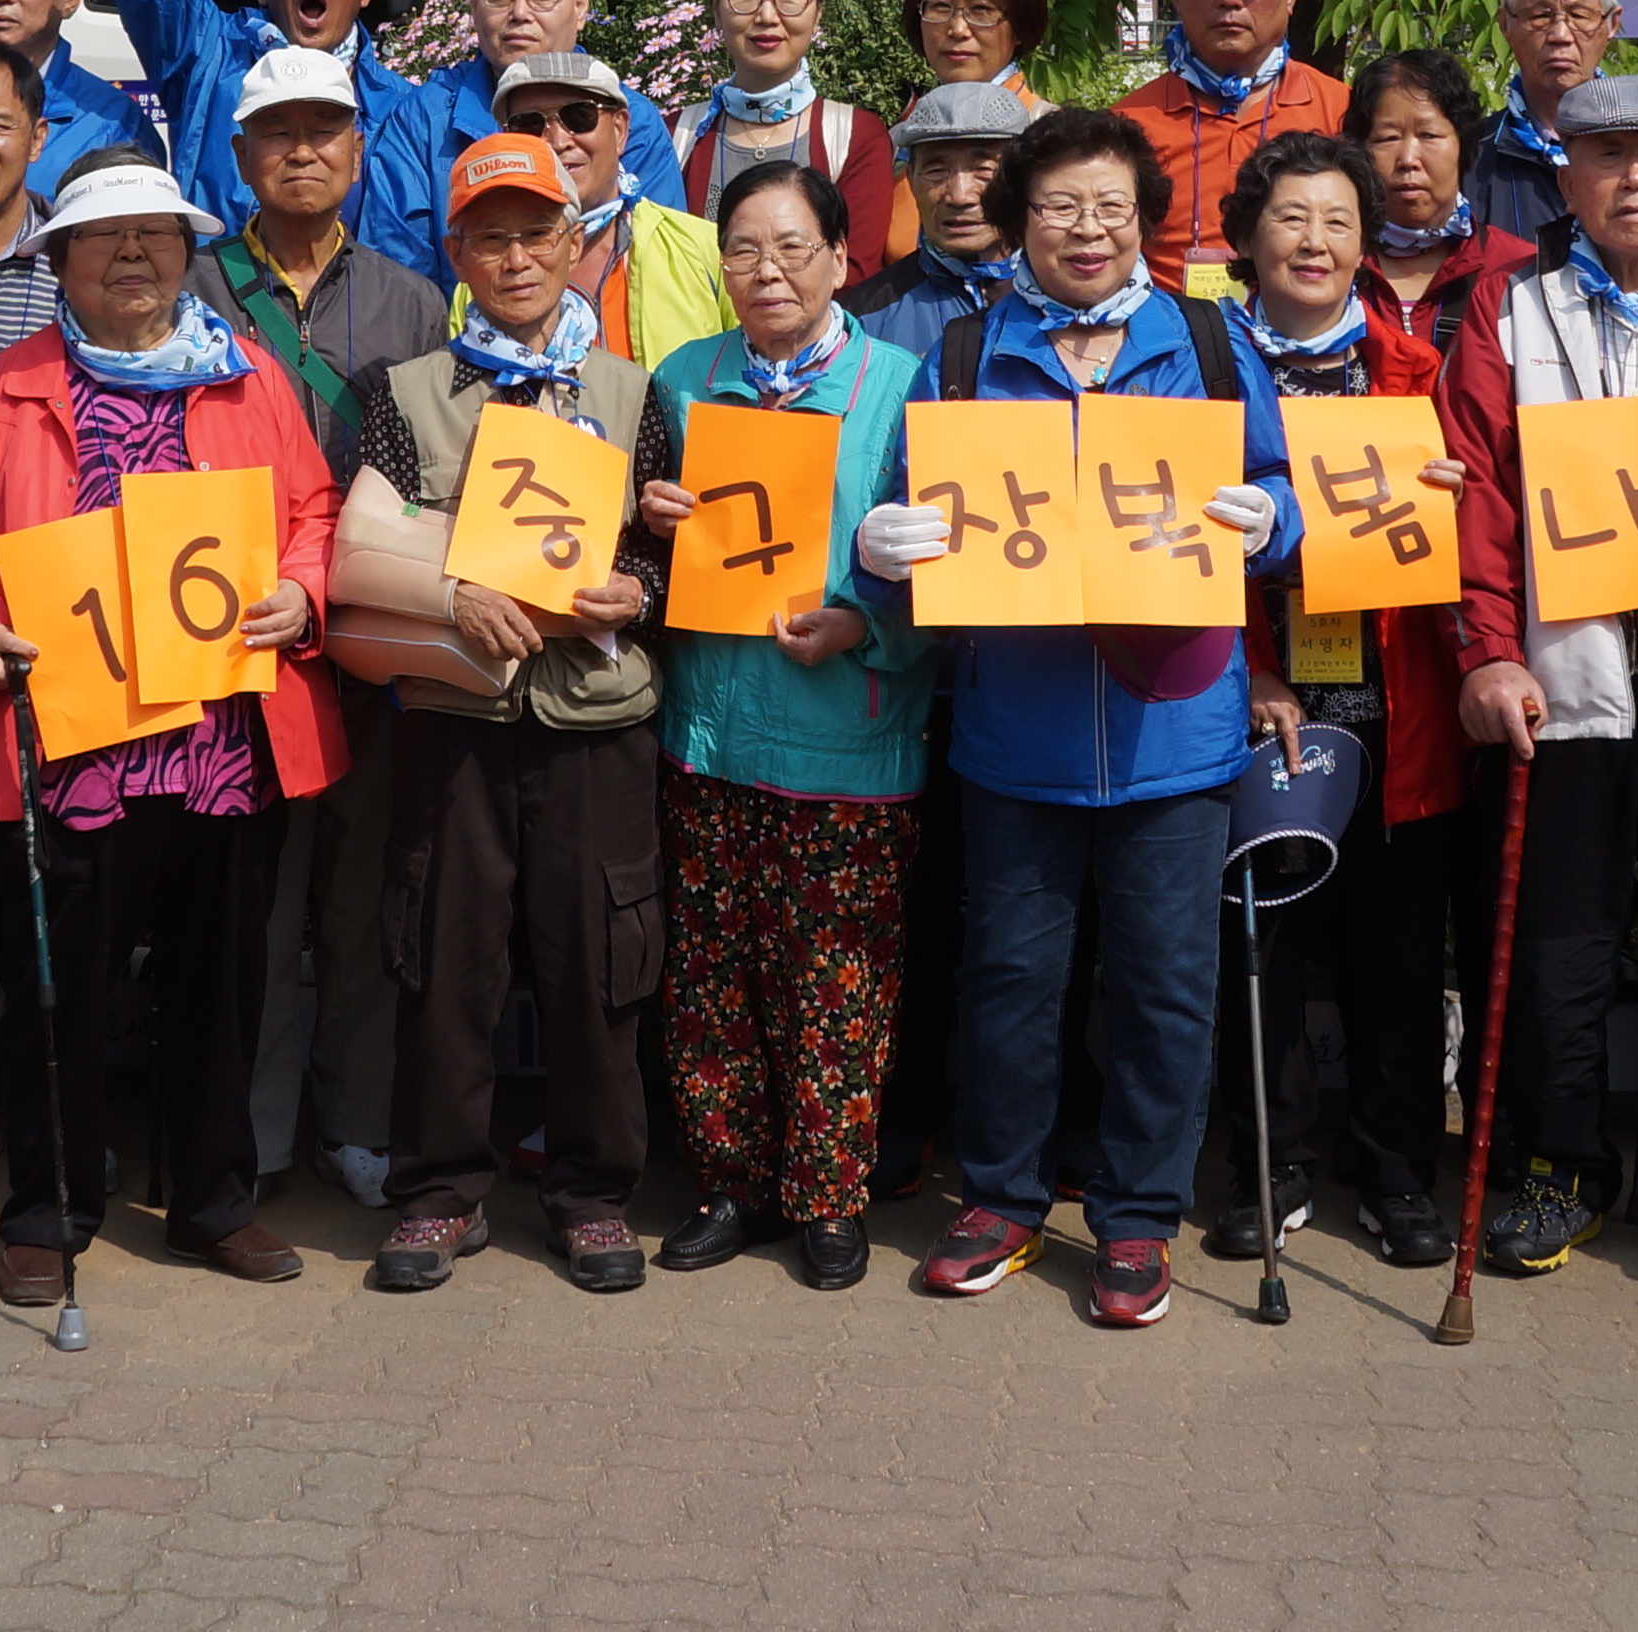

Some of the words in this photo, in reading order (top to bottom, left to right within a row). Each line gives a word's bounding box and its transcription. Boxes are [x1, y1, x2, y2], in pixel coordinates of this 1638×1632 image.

[472, 158, 528, 177] Wilson
[491, 456, 587, 570] 중
[698, 480, 795, 576] 구
[917, 470, 1051, 570] 장
[1098, 458, 1215, 578] 복
[1309, 443, 1434, 567] 봄
[71, 586, 128, 684] 1
[169, 535, 241, 642] 6
[1309, 617, 1342, 628] 5호차
